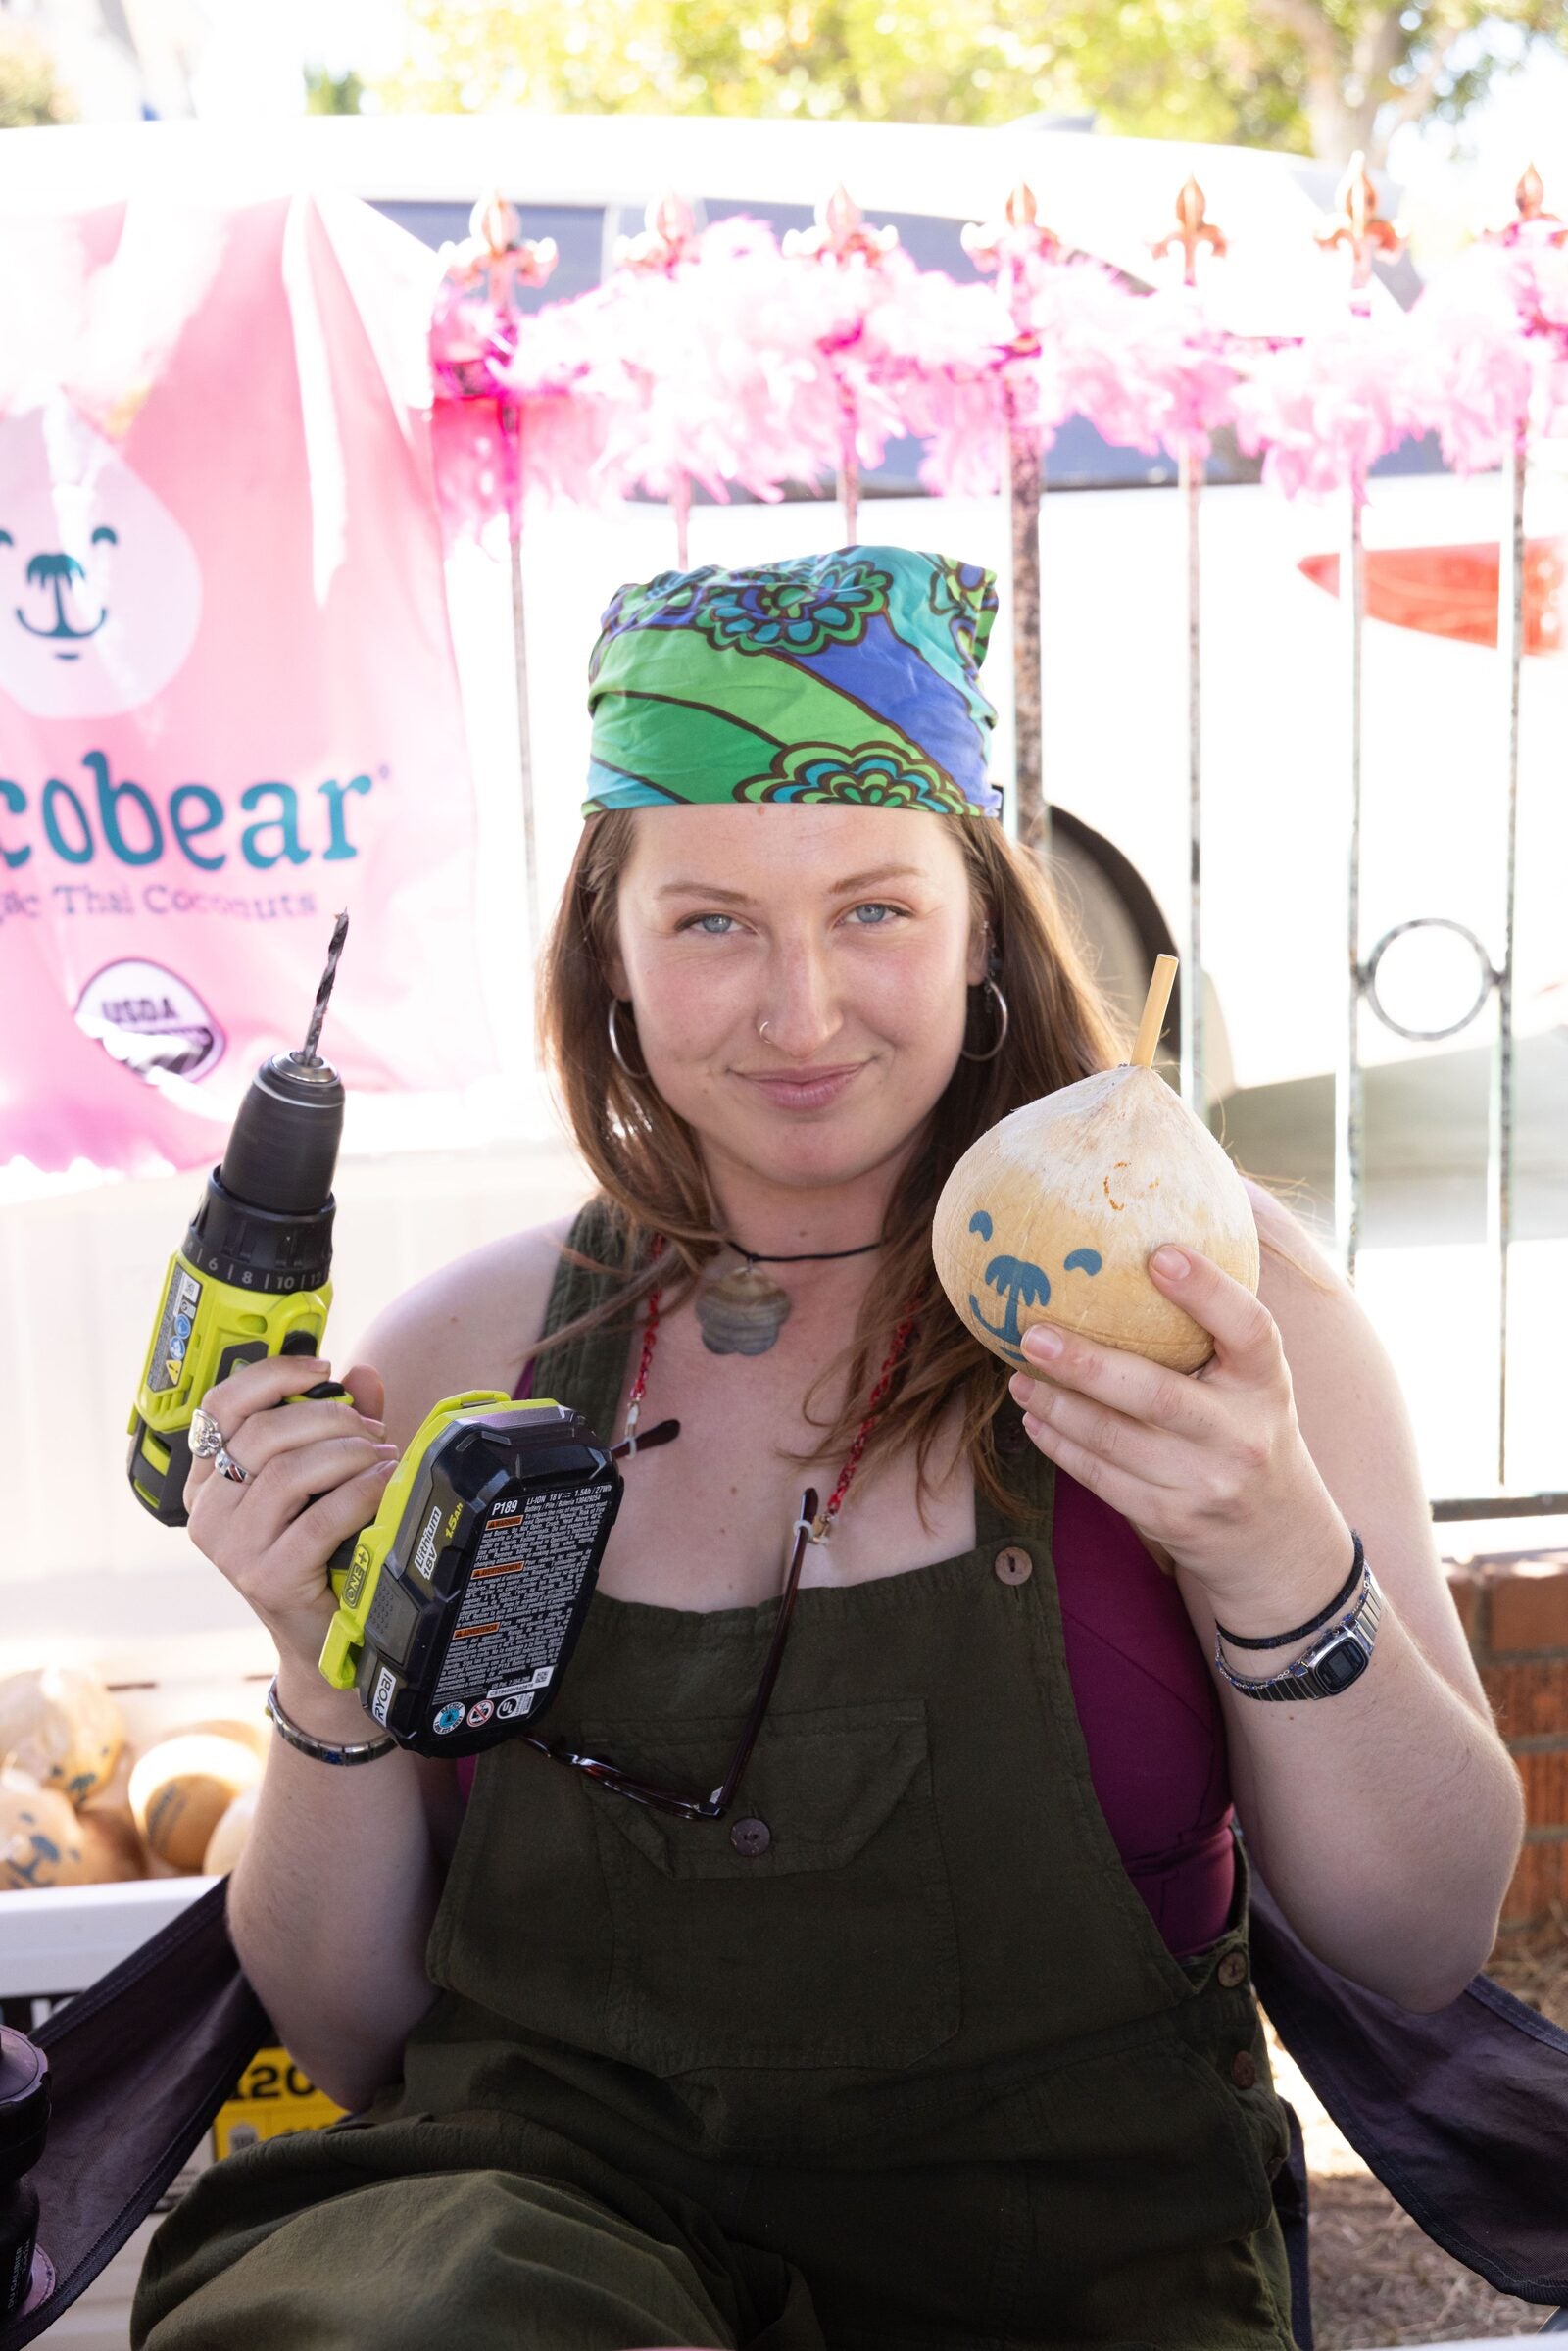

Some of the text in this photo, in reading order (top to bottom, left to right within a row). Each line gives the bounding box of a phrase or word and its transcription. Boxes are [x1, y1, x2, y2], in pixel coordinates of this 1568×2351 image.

[102, 997, 178, 1025] USDA
[209, 1258, 219, 1271] 6
[242, 1271, 253, 1284] 8
[277, 1277, 294, 1289] 10
[491, 1499, 518, 1516] P189
[416, 1510, 440, 1568] Lithium
[423, 1550, 436, 1577] 18V
[374, 1672, 393, 1722] RYOBI
